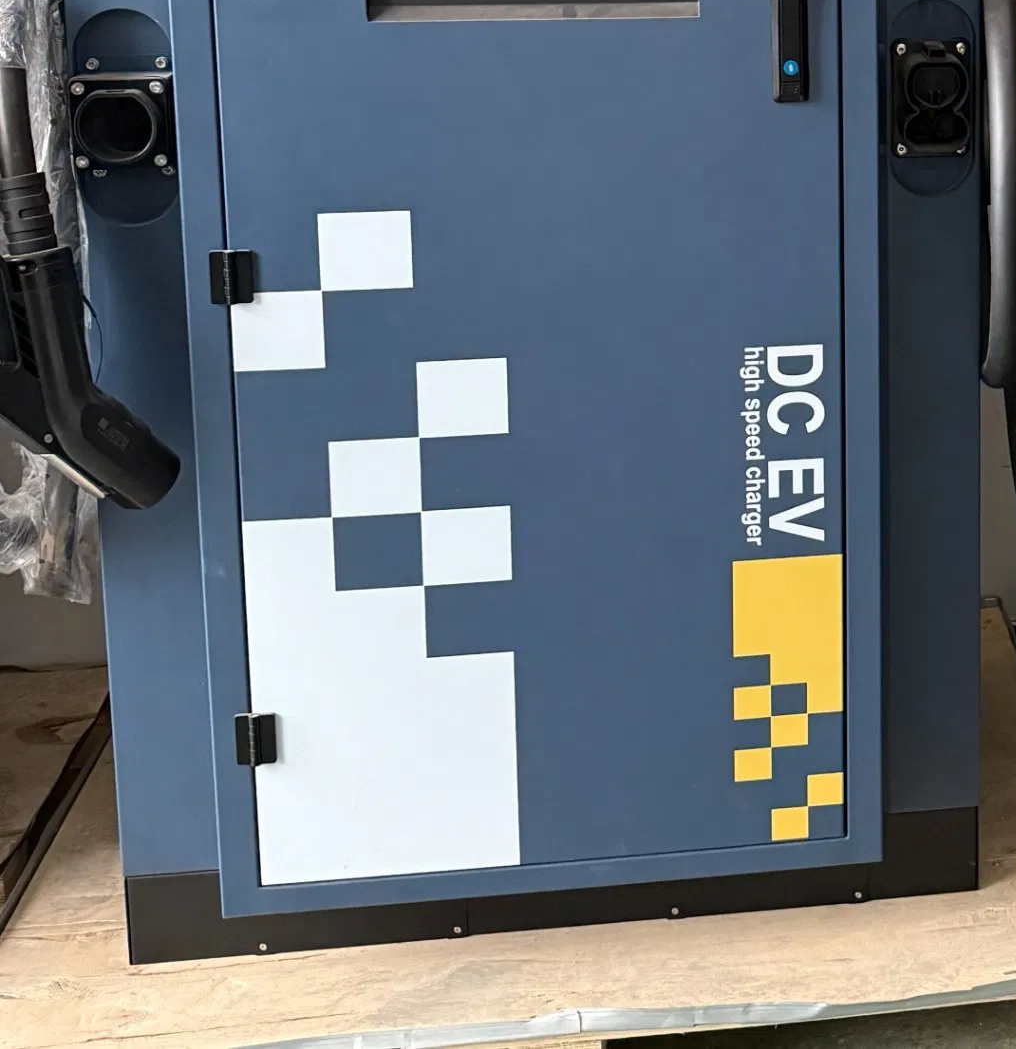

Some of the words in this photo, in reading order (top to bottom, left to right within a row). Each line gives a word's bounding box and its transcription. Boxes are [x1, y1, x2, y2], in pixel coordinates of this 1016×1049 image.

[739, 346, 765, 392] high
[766, 344, 825, 435] DC
[740, 398, 765, 461] speed
[740, 466, 766, 546] charger
[767, 457, 825, 541] EV
